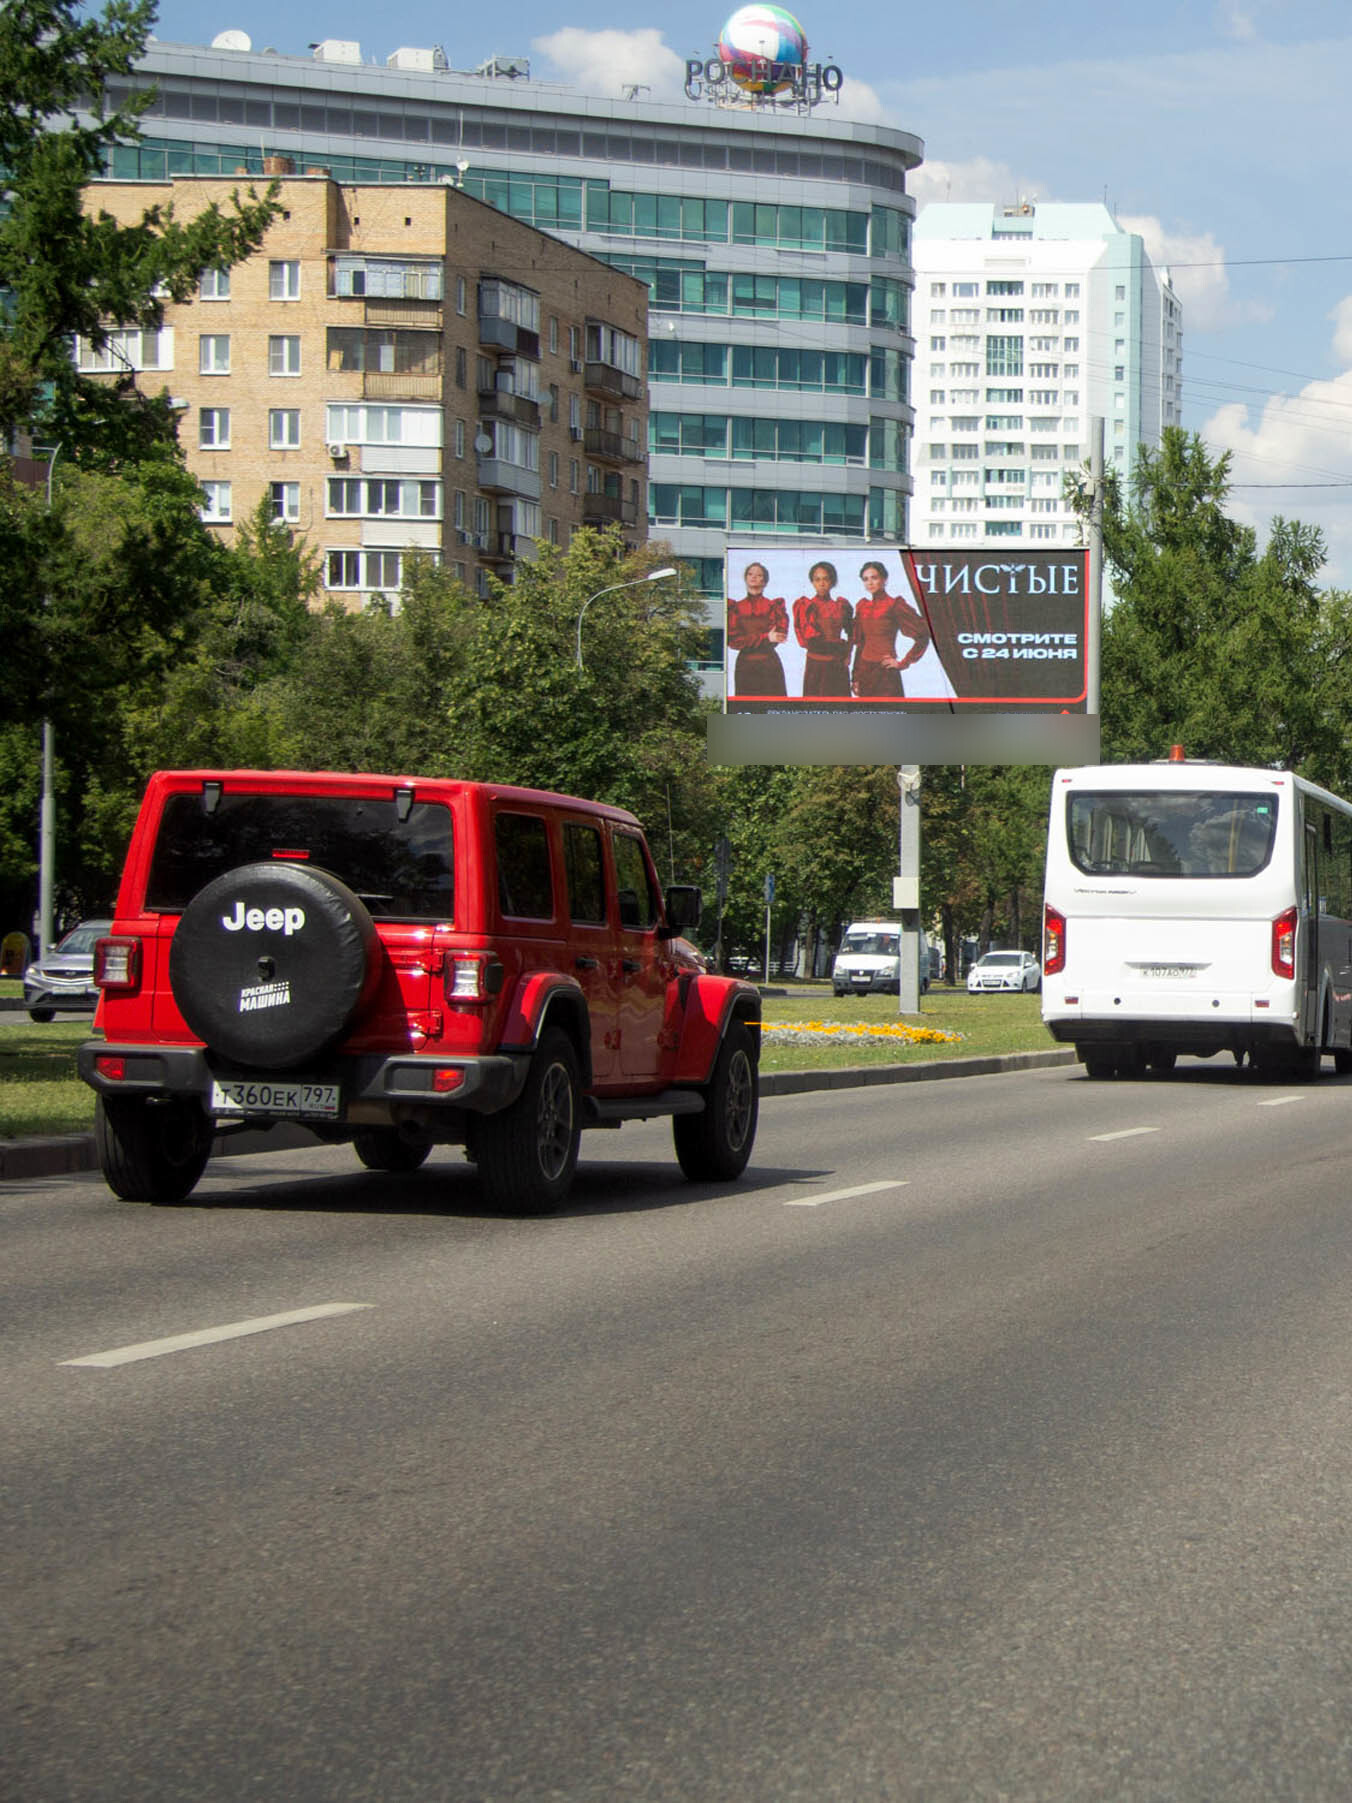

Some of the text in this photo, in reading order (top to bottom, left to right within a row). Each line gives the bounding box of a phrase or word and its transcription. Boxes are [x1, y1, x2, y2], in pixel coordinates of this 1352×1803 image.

[684, 58, 843, 92] РОСНАНО
[914, 562, 1079, 595] ЧИСТЫЕ
[957, 632, 1078, 645] СМОТРИТЕ
[962, 648, 1078, 660] С 24 ИЮНЯ
[222, 902, 305, 936] Jeep
[239, 990, 291, 1013] МАШИНА
